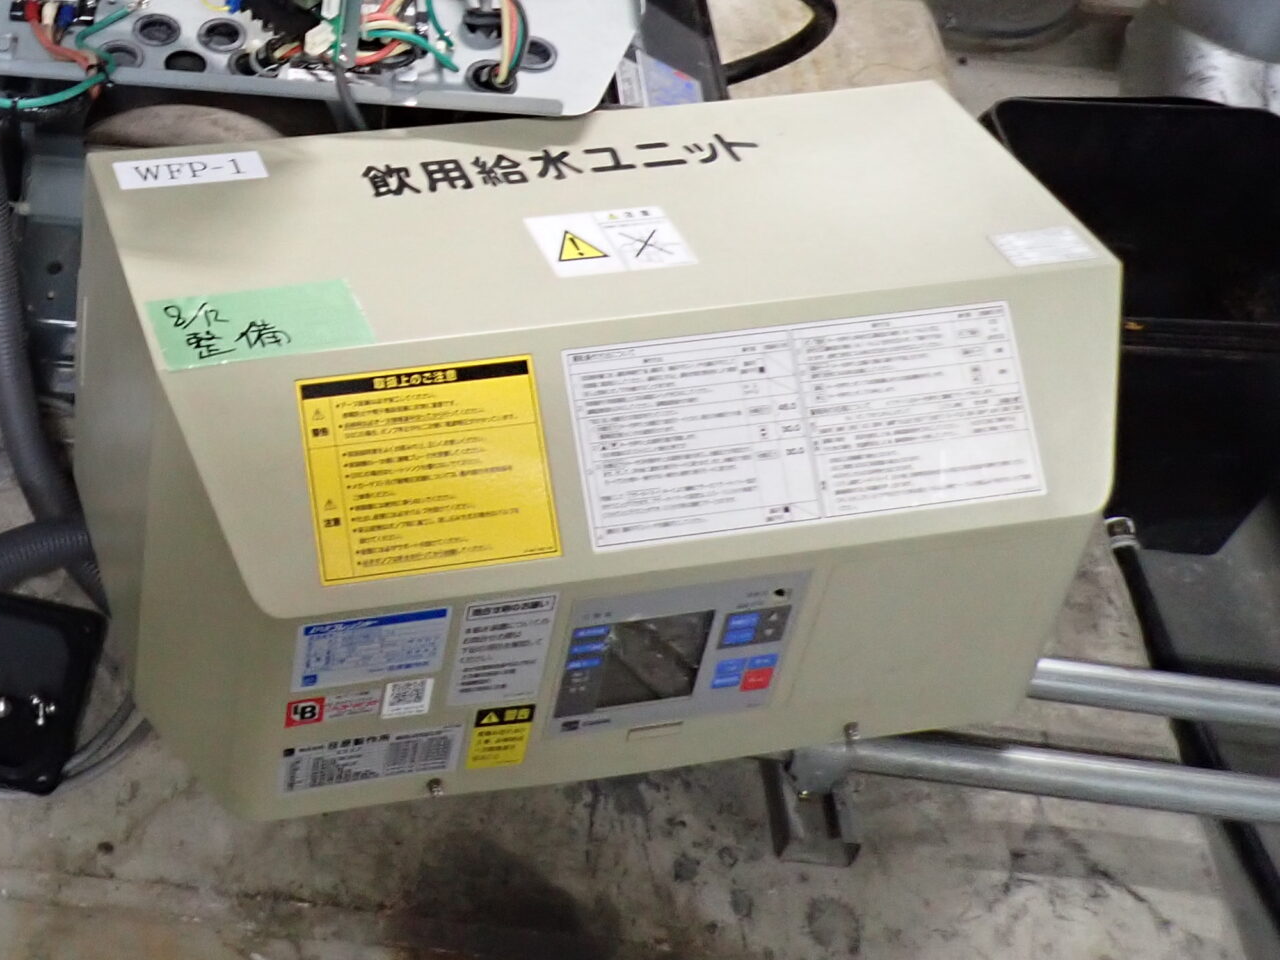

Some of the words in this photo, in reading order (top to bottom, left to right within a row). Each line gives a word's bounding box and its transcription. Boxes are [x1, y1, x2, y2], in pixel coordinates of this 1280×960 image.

[134, 158, 247, 183] WFP-1
[361, 133, 760, 198] 飲用給水ユニット
